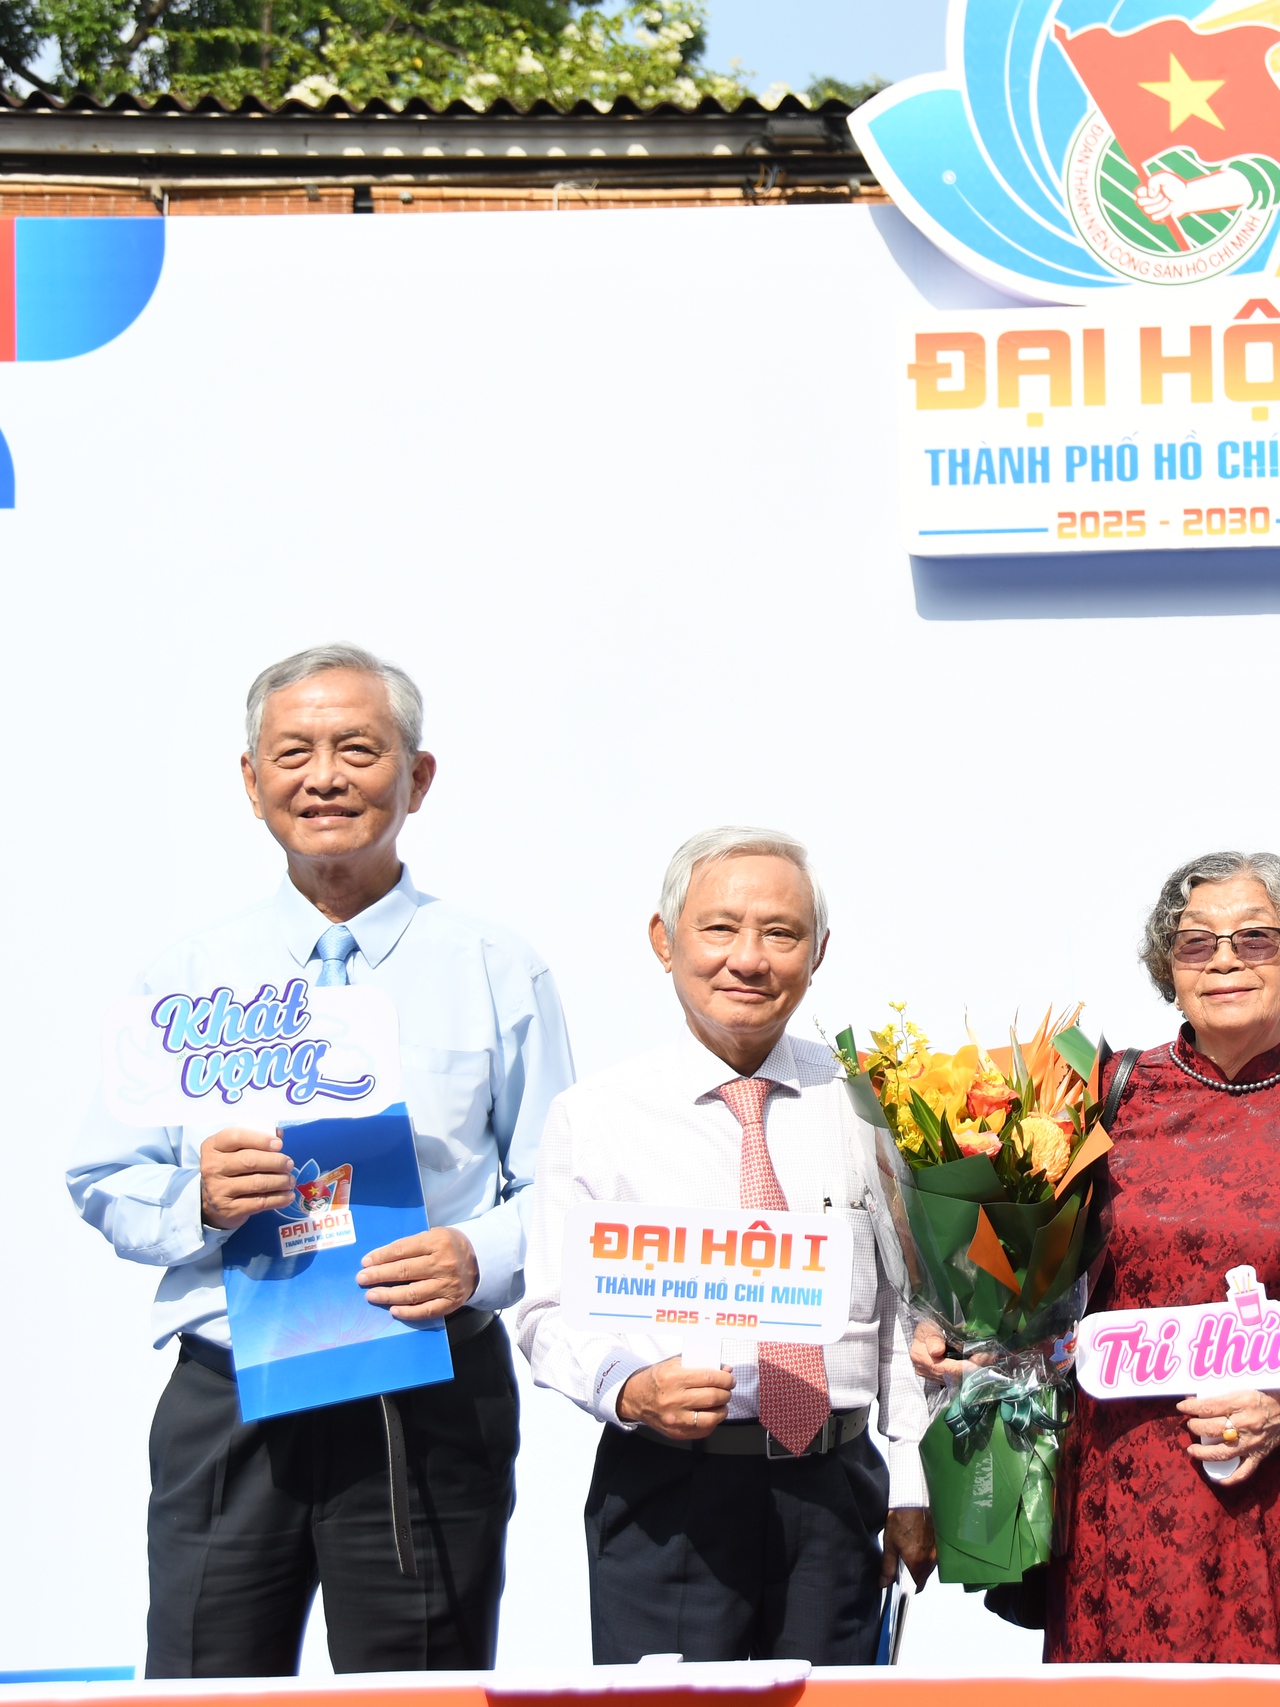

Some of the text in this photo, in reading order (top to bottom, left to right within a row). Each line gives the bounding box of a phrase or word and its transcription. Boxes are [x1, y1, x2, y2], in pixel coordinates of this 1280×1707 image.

[1074, 167, 1089, 218] THANH
[1230, 215, 1260, 250] MINH
[907, 329, 1106, 428] ĐẠI
[924, 441, 1051, 487] THÀNH
[1066, 431, 1140, 483] PHỐ
[1154, 429, 1203, 481] HỒ
[1217, 432, 1280, 478] CHÍ
[1057, 509, 1147, 539] 2025
[1182, 506, 1270, 535] 2030
[151, 977, 310, 1053] Khát
[181, 1039, 375, 1103] vọng
[281, 1221, 309, 1238] ĐẠI
[312, 1214, 339, 1231] HỘI
[589, 1220, 828, 1277] ĐẠI HỘI I
[595, 1274, 823, 1306] THÀNH PHỐ HỒ CHÍ MINH
[655, 1309, 699, 1325] 2025
[715, 1312, 758, 1328] 2030
[1094, 1317, 1181, 1388] Tri
